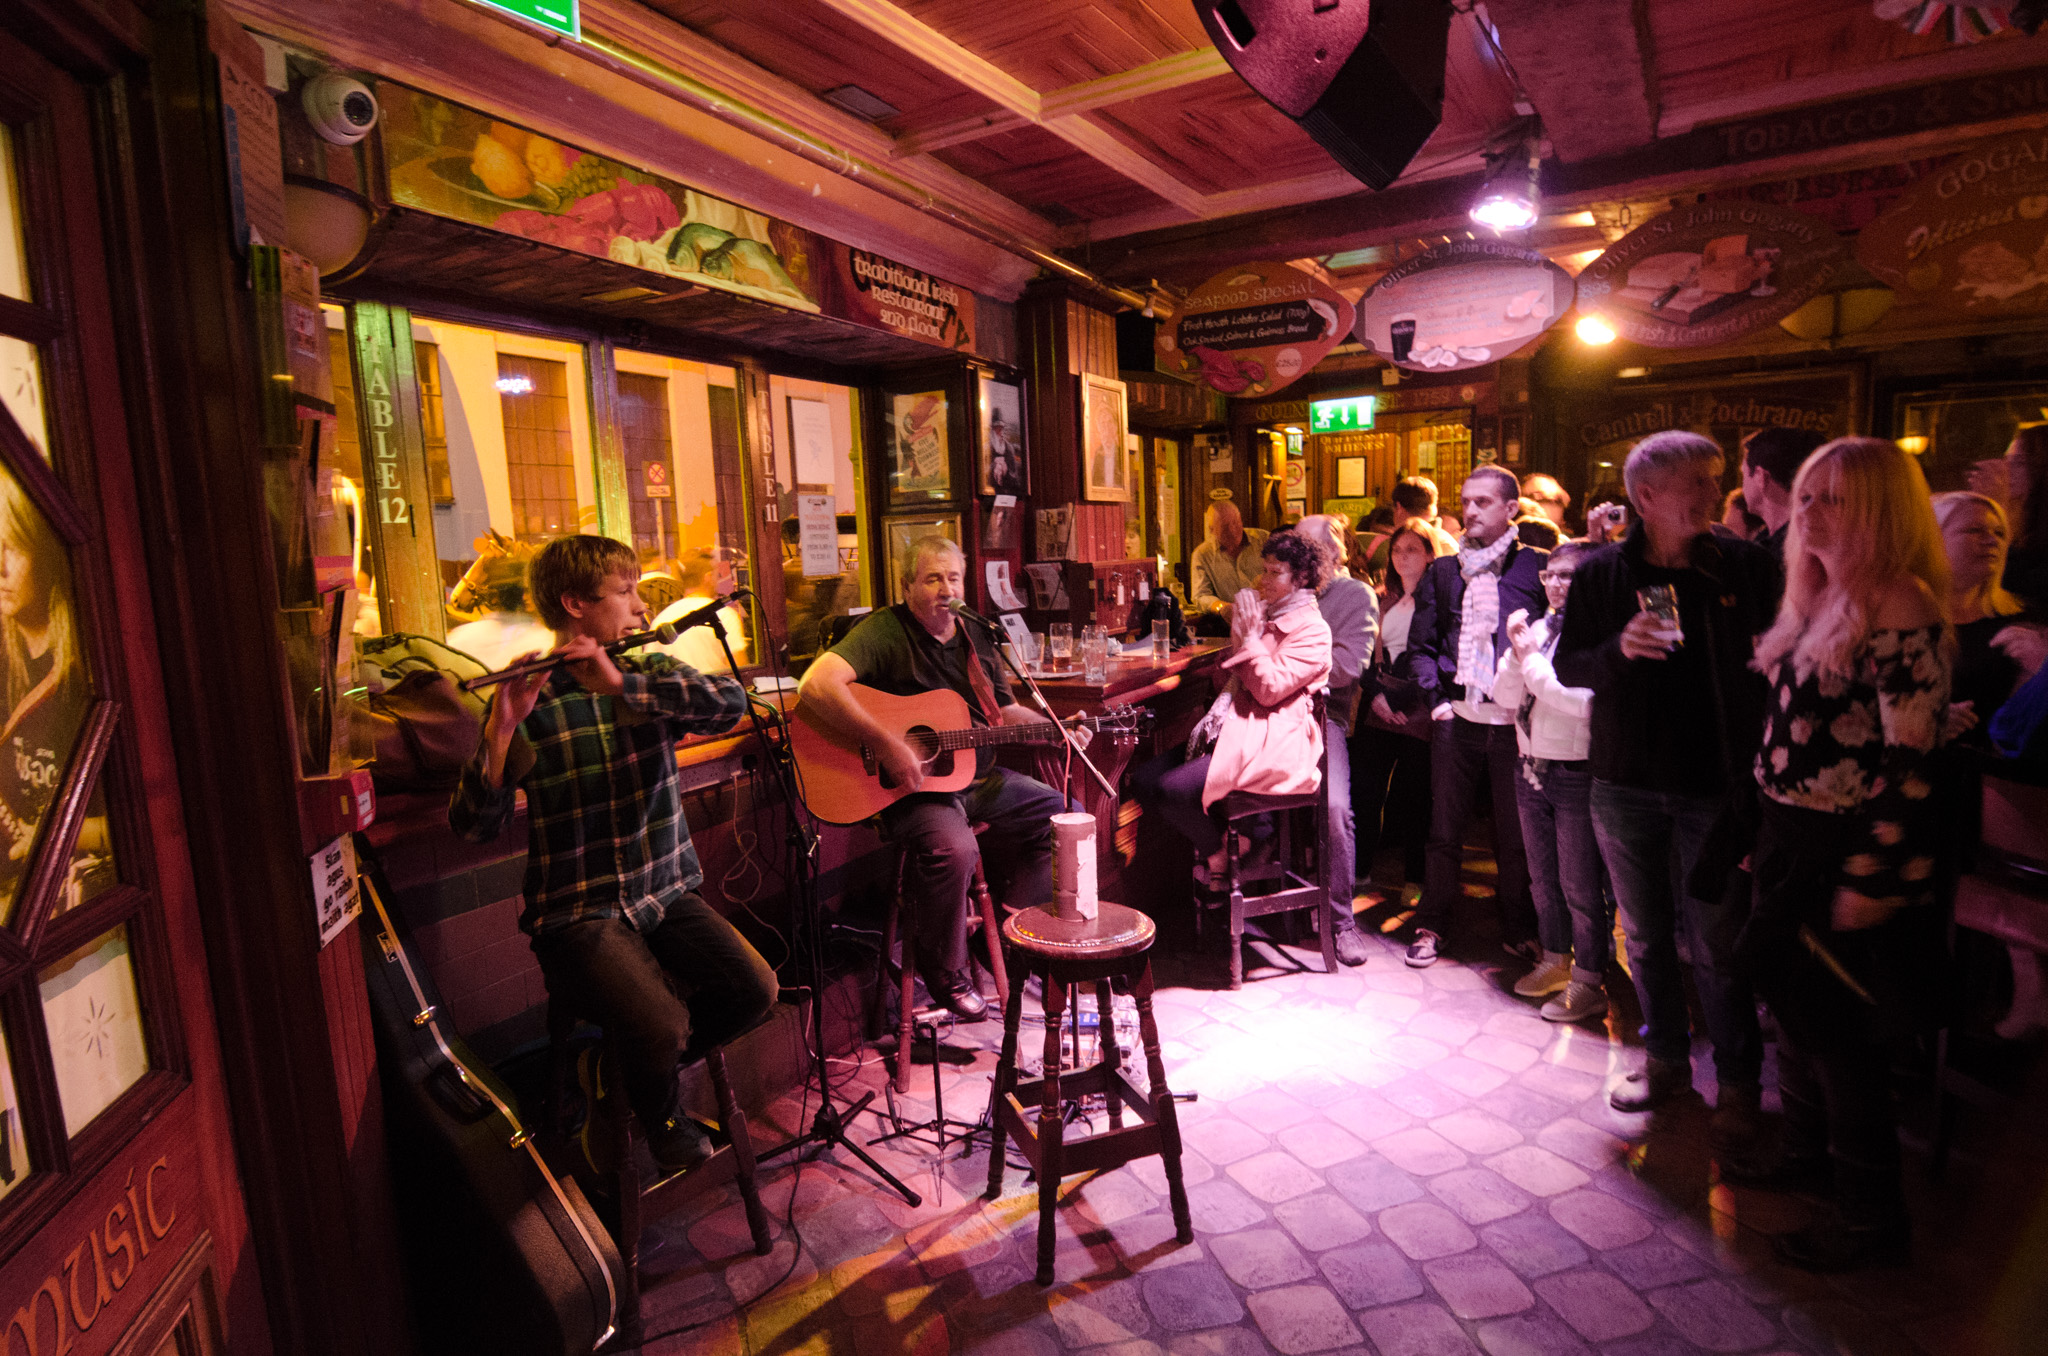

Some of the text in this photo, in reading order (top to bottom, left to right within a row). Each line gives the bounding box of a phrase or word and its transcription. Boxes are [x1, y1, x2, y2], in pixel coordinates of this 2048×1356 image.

[1719, 103, 1897, 156] TOBACCO
[1380, 257, 1420, 289] Oliver
[1448, 242, 1480, 255] John
[1594, 235, 1647, 281] Oliver
[1686, 207, 1732, 228] John
[1739, 208, 1817, 244] Gogarty
[367, 334, 409, 524] TABLE 12
[1580, 402, 1674, 446] Cantrell
[757, 390, 779, 522] TABLE 11
